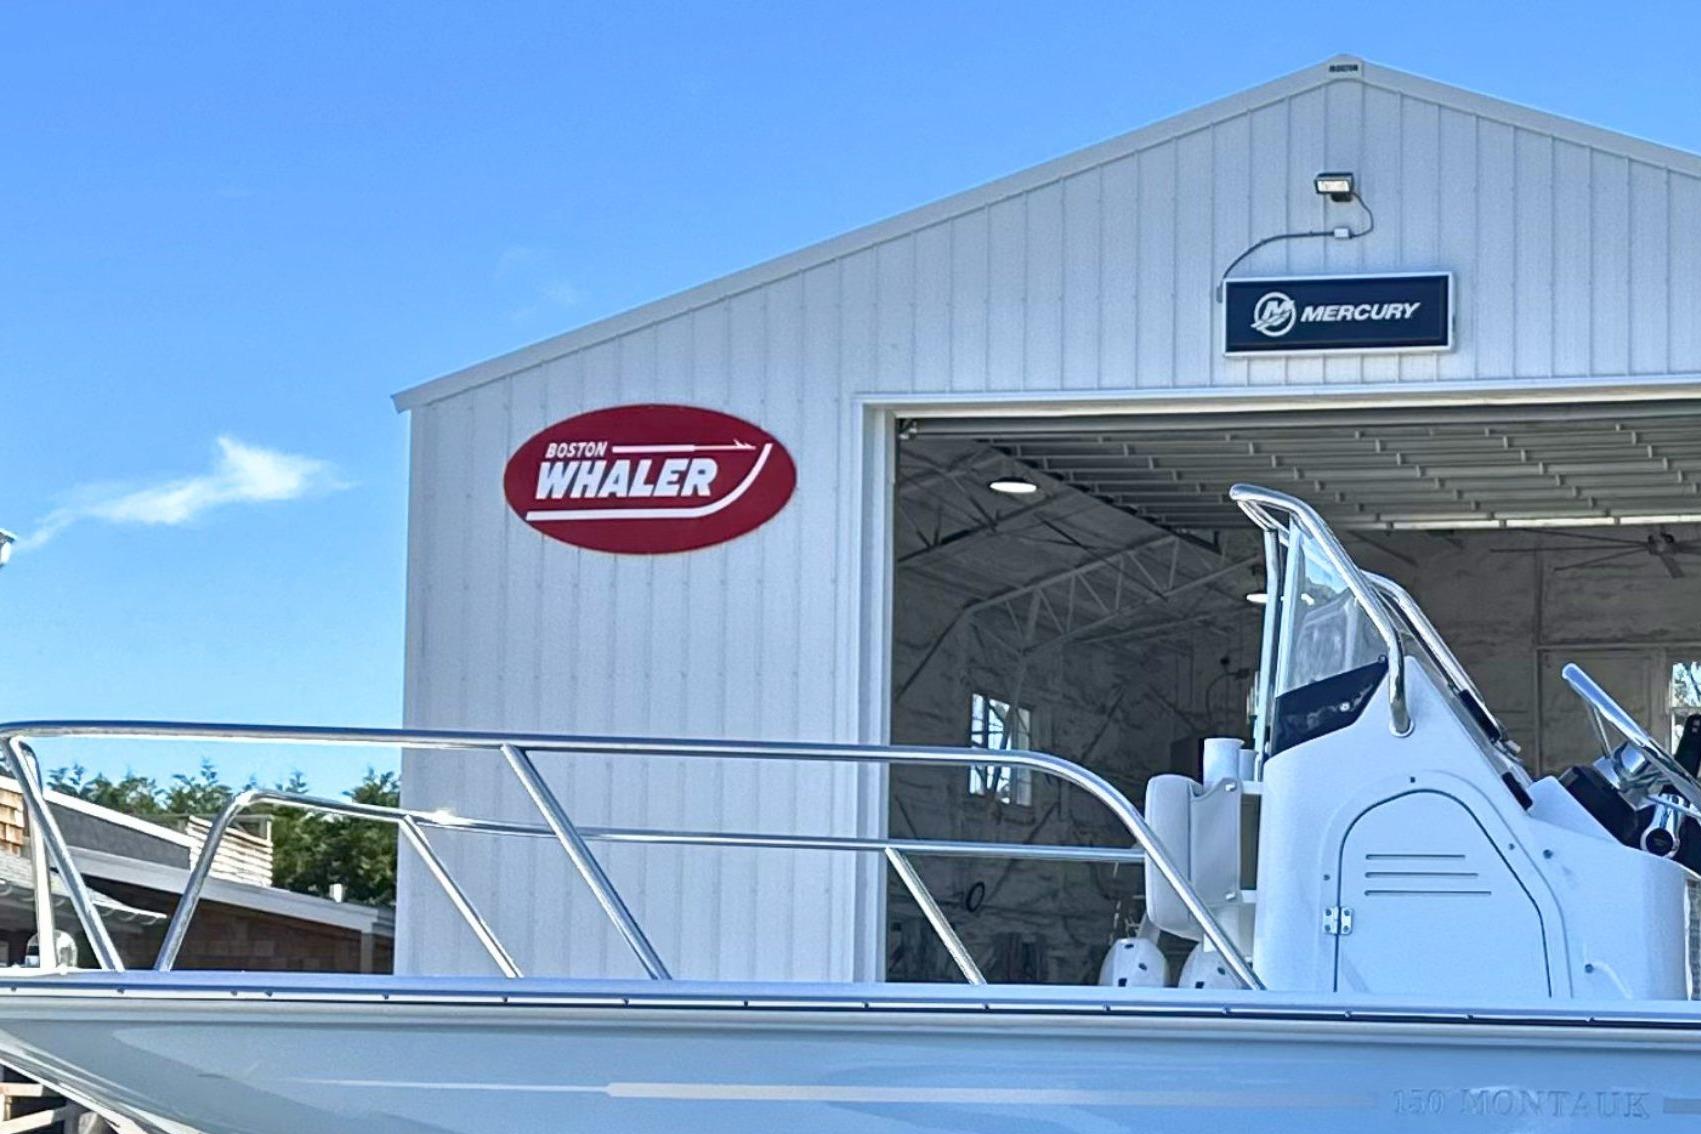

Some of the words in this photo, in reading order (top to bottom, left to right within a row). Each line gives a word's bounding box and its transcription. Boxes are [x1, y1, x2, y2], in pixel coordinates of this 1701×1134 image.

[1300, 302, 1420, 323] MERCURY
[545, 441, 608, 459] BOSTON
[535, 457, 718, 500] WHALER
[1460, 1087, 1651, 1119] MONTAUK
